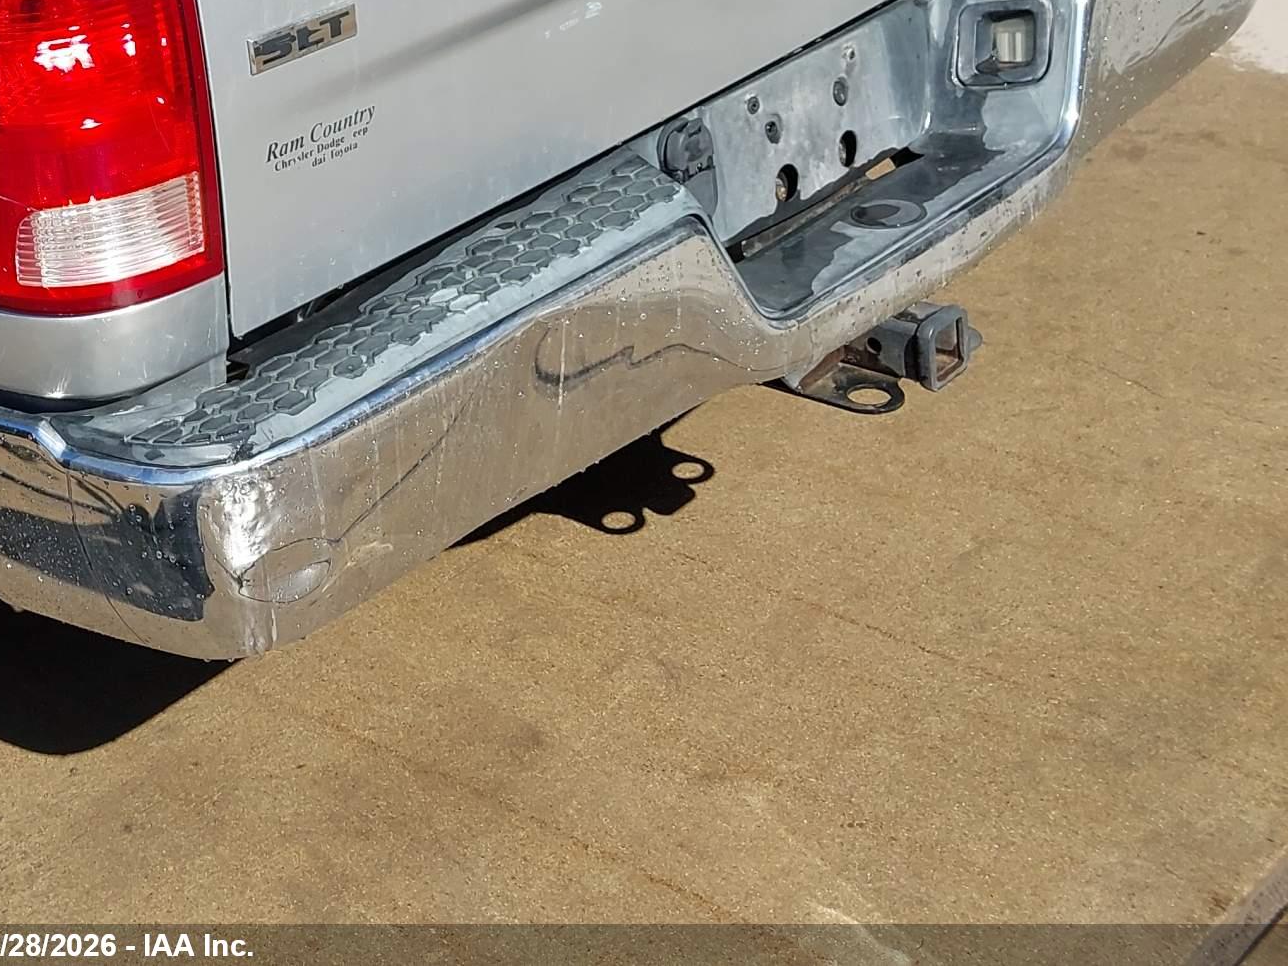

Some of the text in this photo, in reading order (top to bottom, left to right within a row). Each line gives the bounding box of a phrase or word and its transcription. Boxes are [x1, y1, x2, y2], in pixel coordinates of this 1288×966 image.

[254, 11, 350, 65] SLT
[266, 106, 375, 163] Ram Country
[274, 149, 314, 172] Chrysler
[317, 136, 345, 154] Dodge
